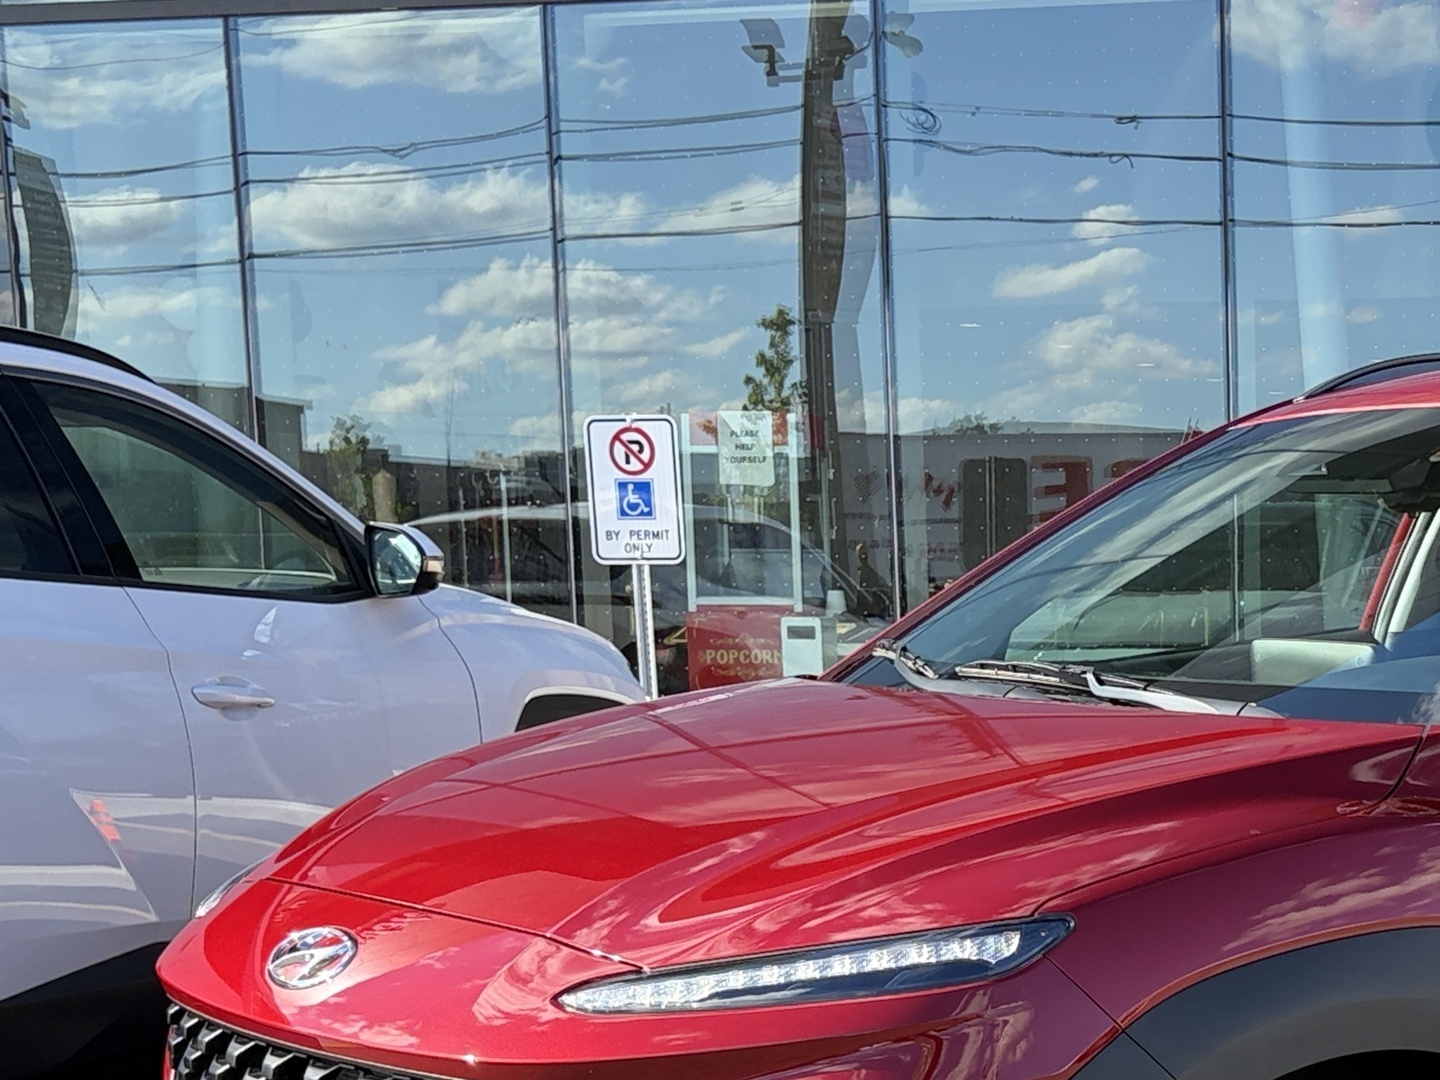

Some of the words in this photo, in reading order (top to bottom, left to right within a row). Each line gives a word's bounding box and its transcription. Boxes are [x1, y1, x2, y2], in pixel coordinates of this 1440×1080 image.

[730, 430, 760, 438] PLEASE
[605, 529, 621, 541] BY
[629, 529, 670, 541] PERMIT
[624, 542, 653, 555] ONLY
